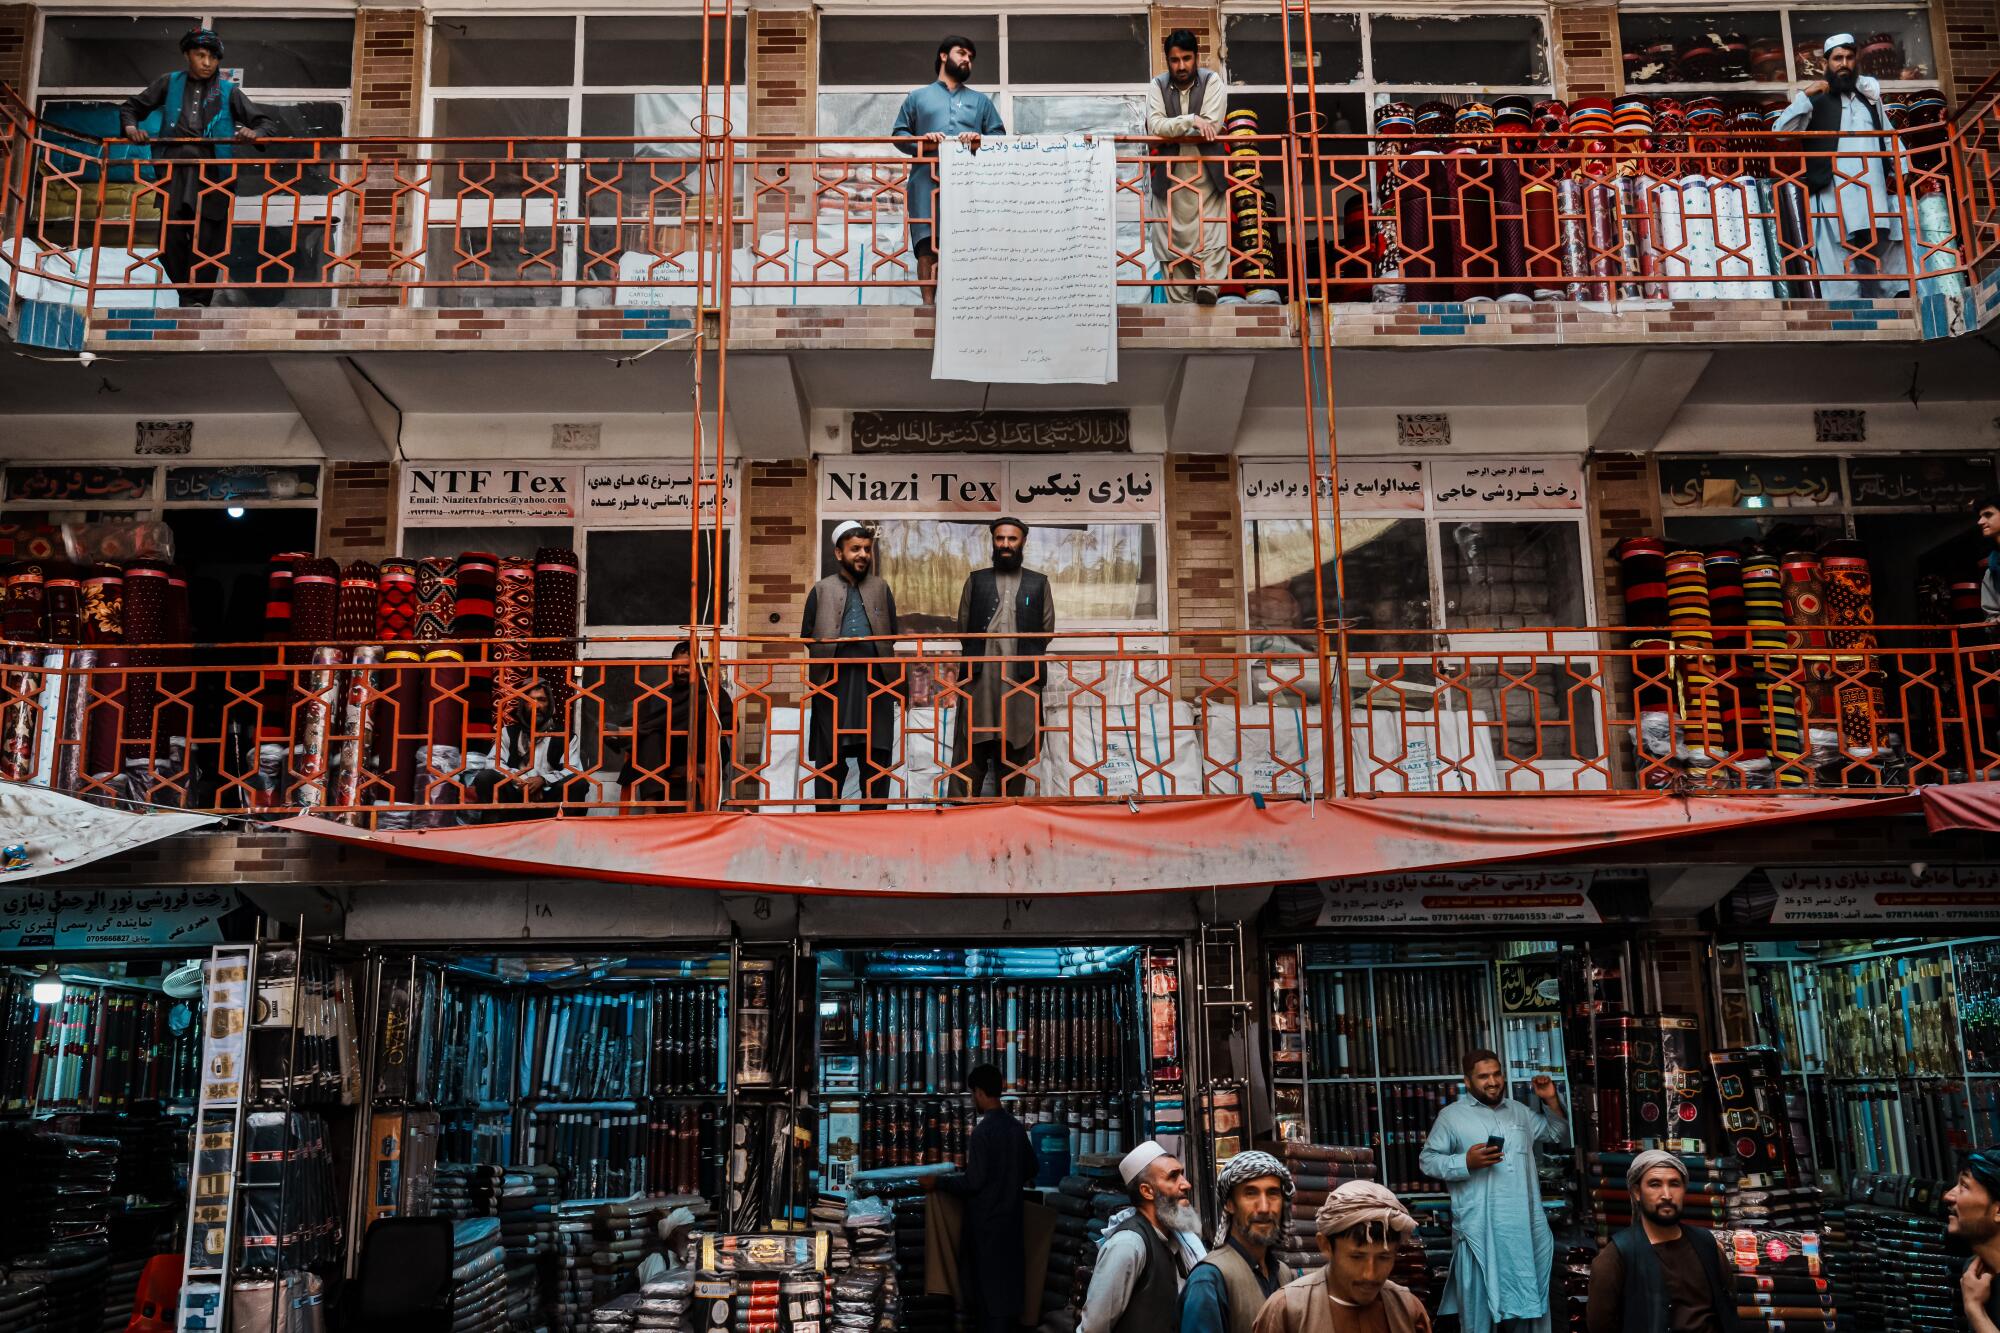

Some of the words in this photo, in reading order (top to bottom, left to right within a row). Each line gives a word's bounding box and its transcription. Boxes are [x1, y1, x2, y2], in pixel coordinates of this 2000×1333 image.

[1466, 467, 1490, 477] الرحیم
[1491, 466, 1517, 477] الرحمن
[1519, 465, 1530, 474] الله
[1531, 466, 1544, 475] بسم
[410, 471, 492, 493] NTF
[504, 471, 567, 493] Tex
[827, 472, 919, 502] Niazi
[932, 473, 998, 502] Tex
[1015, 472, 1082, 504] تیکس
[1088, 472, 1153, 505] نیازی
[1246, 478, 1298, 497] برادران
[1302, 484, 1309, 497] و
[1353, 478, 1421, 496] عبدالواسع
[1764, 465, 1831, 502] رخت
[1437, 483, 1477, 502] حاجی
[1482, 482, 1539, 502] فروشی
[1543, 482, 1577, 501] رخت
[409, 496, 440, 504] Email:
[442, 496, 567, 506] Niazitexfabrics@yahoo.com
[1329, 879, 1368, 893] پسران
[1383, 876, 1418, 892] نیازی
[1421, 874, 1454, 888] ملنگ
[1458, 873, 1498, 891] حاجی
[1502, 872, 1546, 891] فروشی
[1550, 873, 1583, 890] رخت
[1782, 872, 1820, 890] پسران
[1825, 877, 1831, 889] و
[1835, 871, 1869, 889] نیازی
[1873, 871, 1906, 884] ملنگ
[1372, 881, 1379, 893] و
[3, 892, 44, 916] نیازی
[108, 890, 133, 913] نور
[136, 888, 188, 912] فروشی
[192, 888, 230, 909] رخت
[1784, 896, 1795, 904] 26
[1802, 896, 1812, 904] 25
[1833, 896, 1857, 906] دوکان
[61, 920, 92, 933] رسمی
